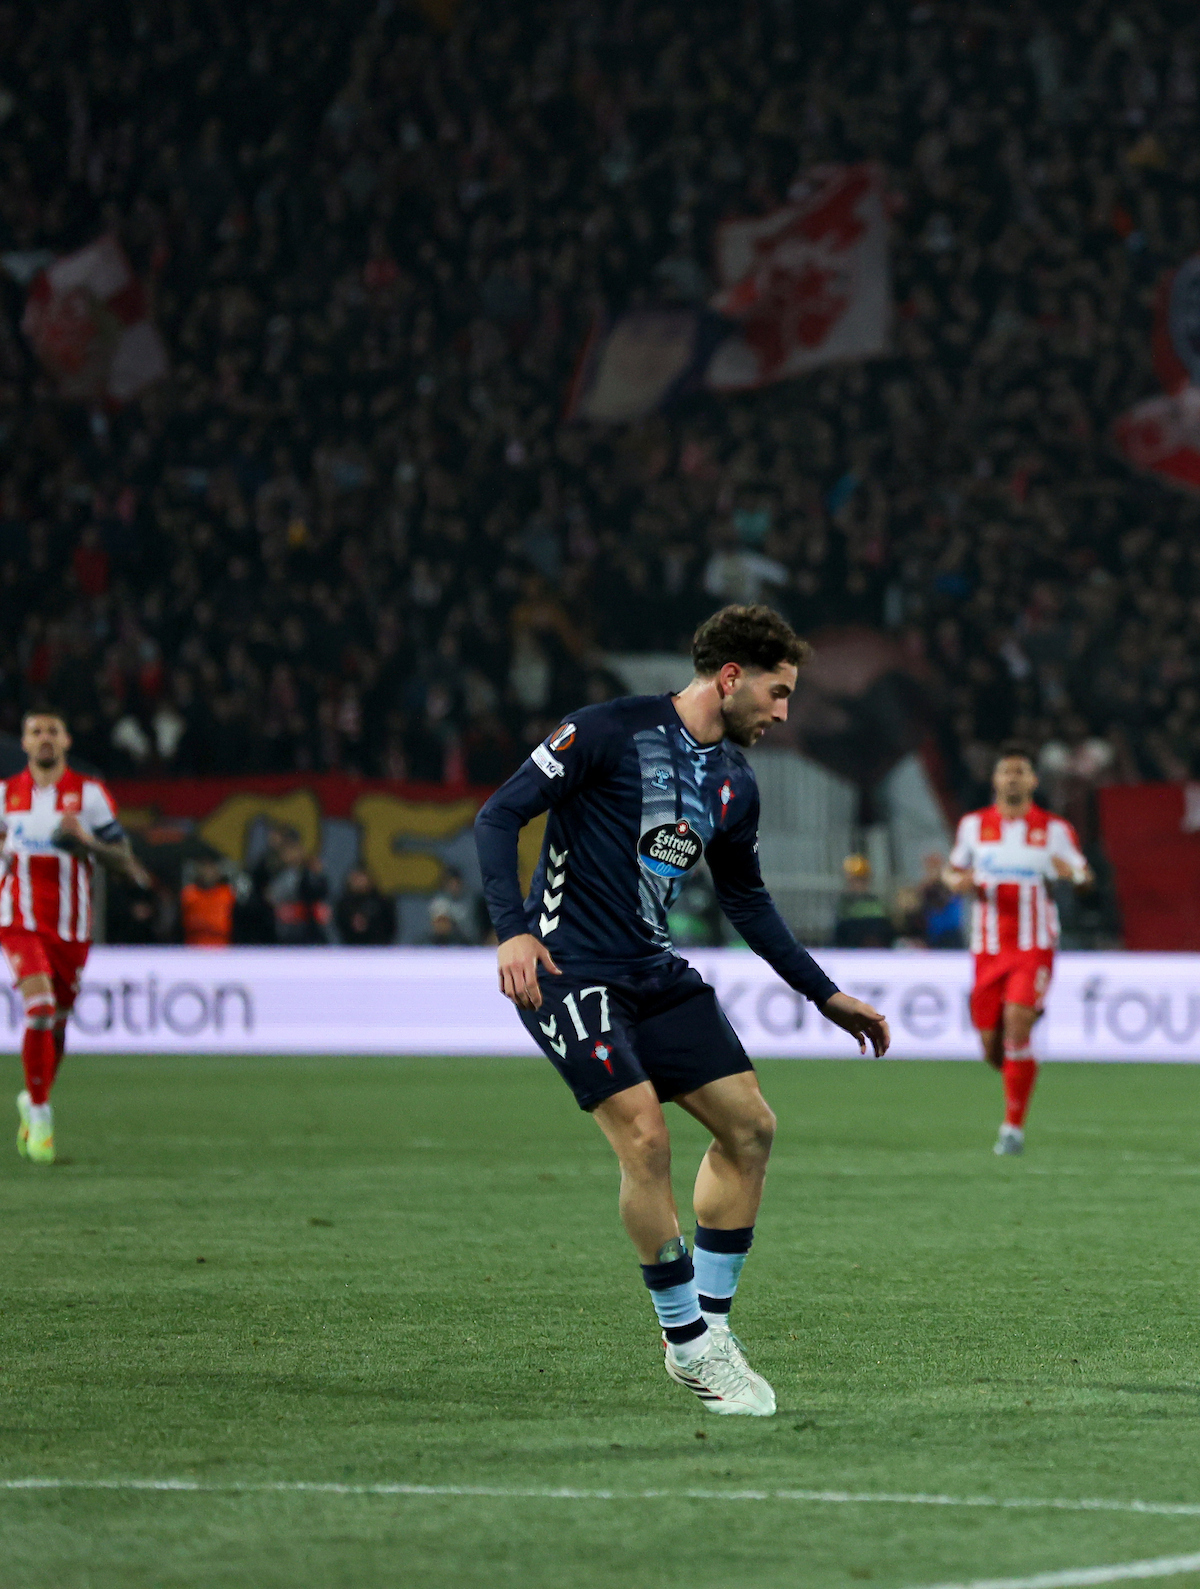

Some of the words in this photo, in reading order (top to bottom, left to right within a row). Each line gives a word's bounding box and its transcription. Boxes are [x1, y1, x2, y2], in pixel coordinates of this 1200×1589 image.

[650, 843, 688, 867] Galicia
[654, 829, 697, 855] Estrella
[562, 986, 611, 1041] 17
